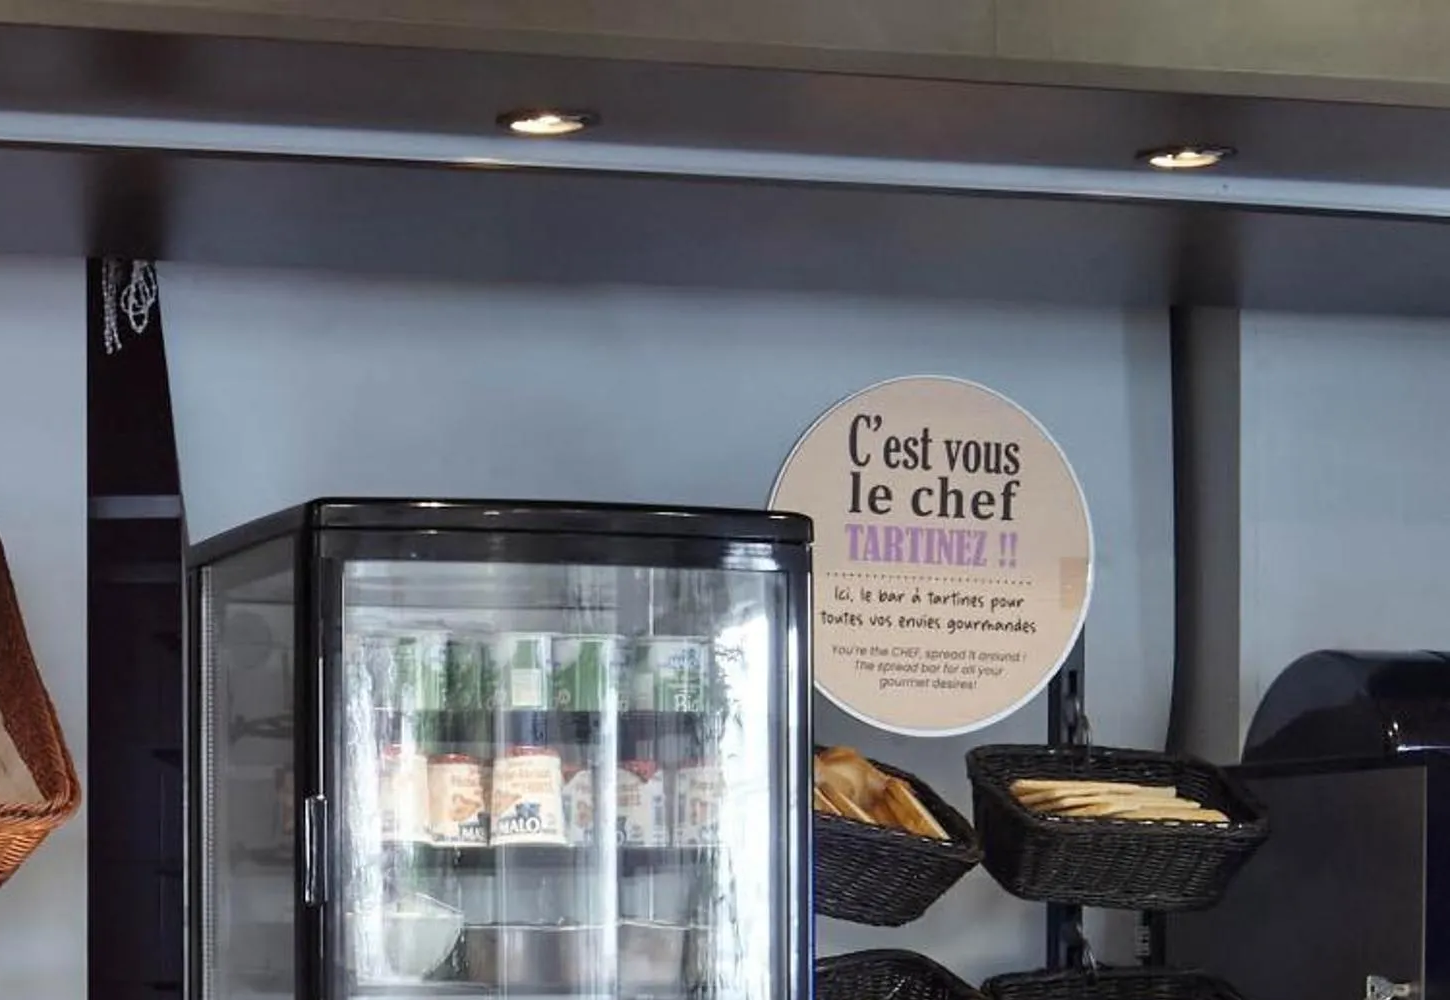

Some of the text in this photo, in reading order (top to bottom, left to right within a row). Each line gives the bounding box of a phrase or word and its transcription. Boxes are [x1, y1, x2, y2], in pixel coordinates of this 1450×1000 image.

[849, 414, 1020, 476] C'est vous
[848, 471, 1020, 521] le chef
[844, 523, 1019, 568] TARTINEZ !!
[834, 586, 854, 602] Ici,
[860, 588, 872, 603] le
[879, 589, 905, 603] bar
[927, 591, 984, 608] tartines
[990, 598, 1025, 613] pour
[820, 610, 1038, 634] toutes vos envies gourmandes
[832, 645, 867, 656] You're
[869, 646, 889, 657] the
[924, 649, 965, 662] spread
[977, 653, 1019, 662] around
[855, 660, 1003, 678] The spread bar for all your
[879, 677, 977, 690] gourmet desires!
